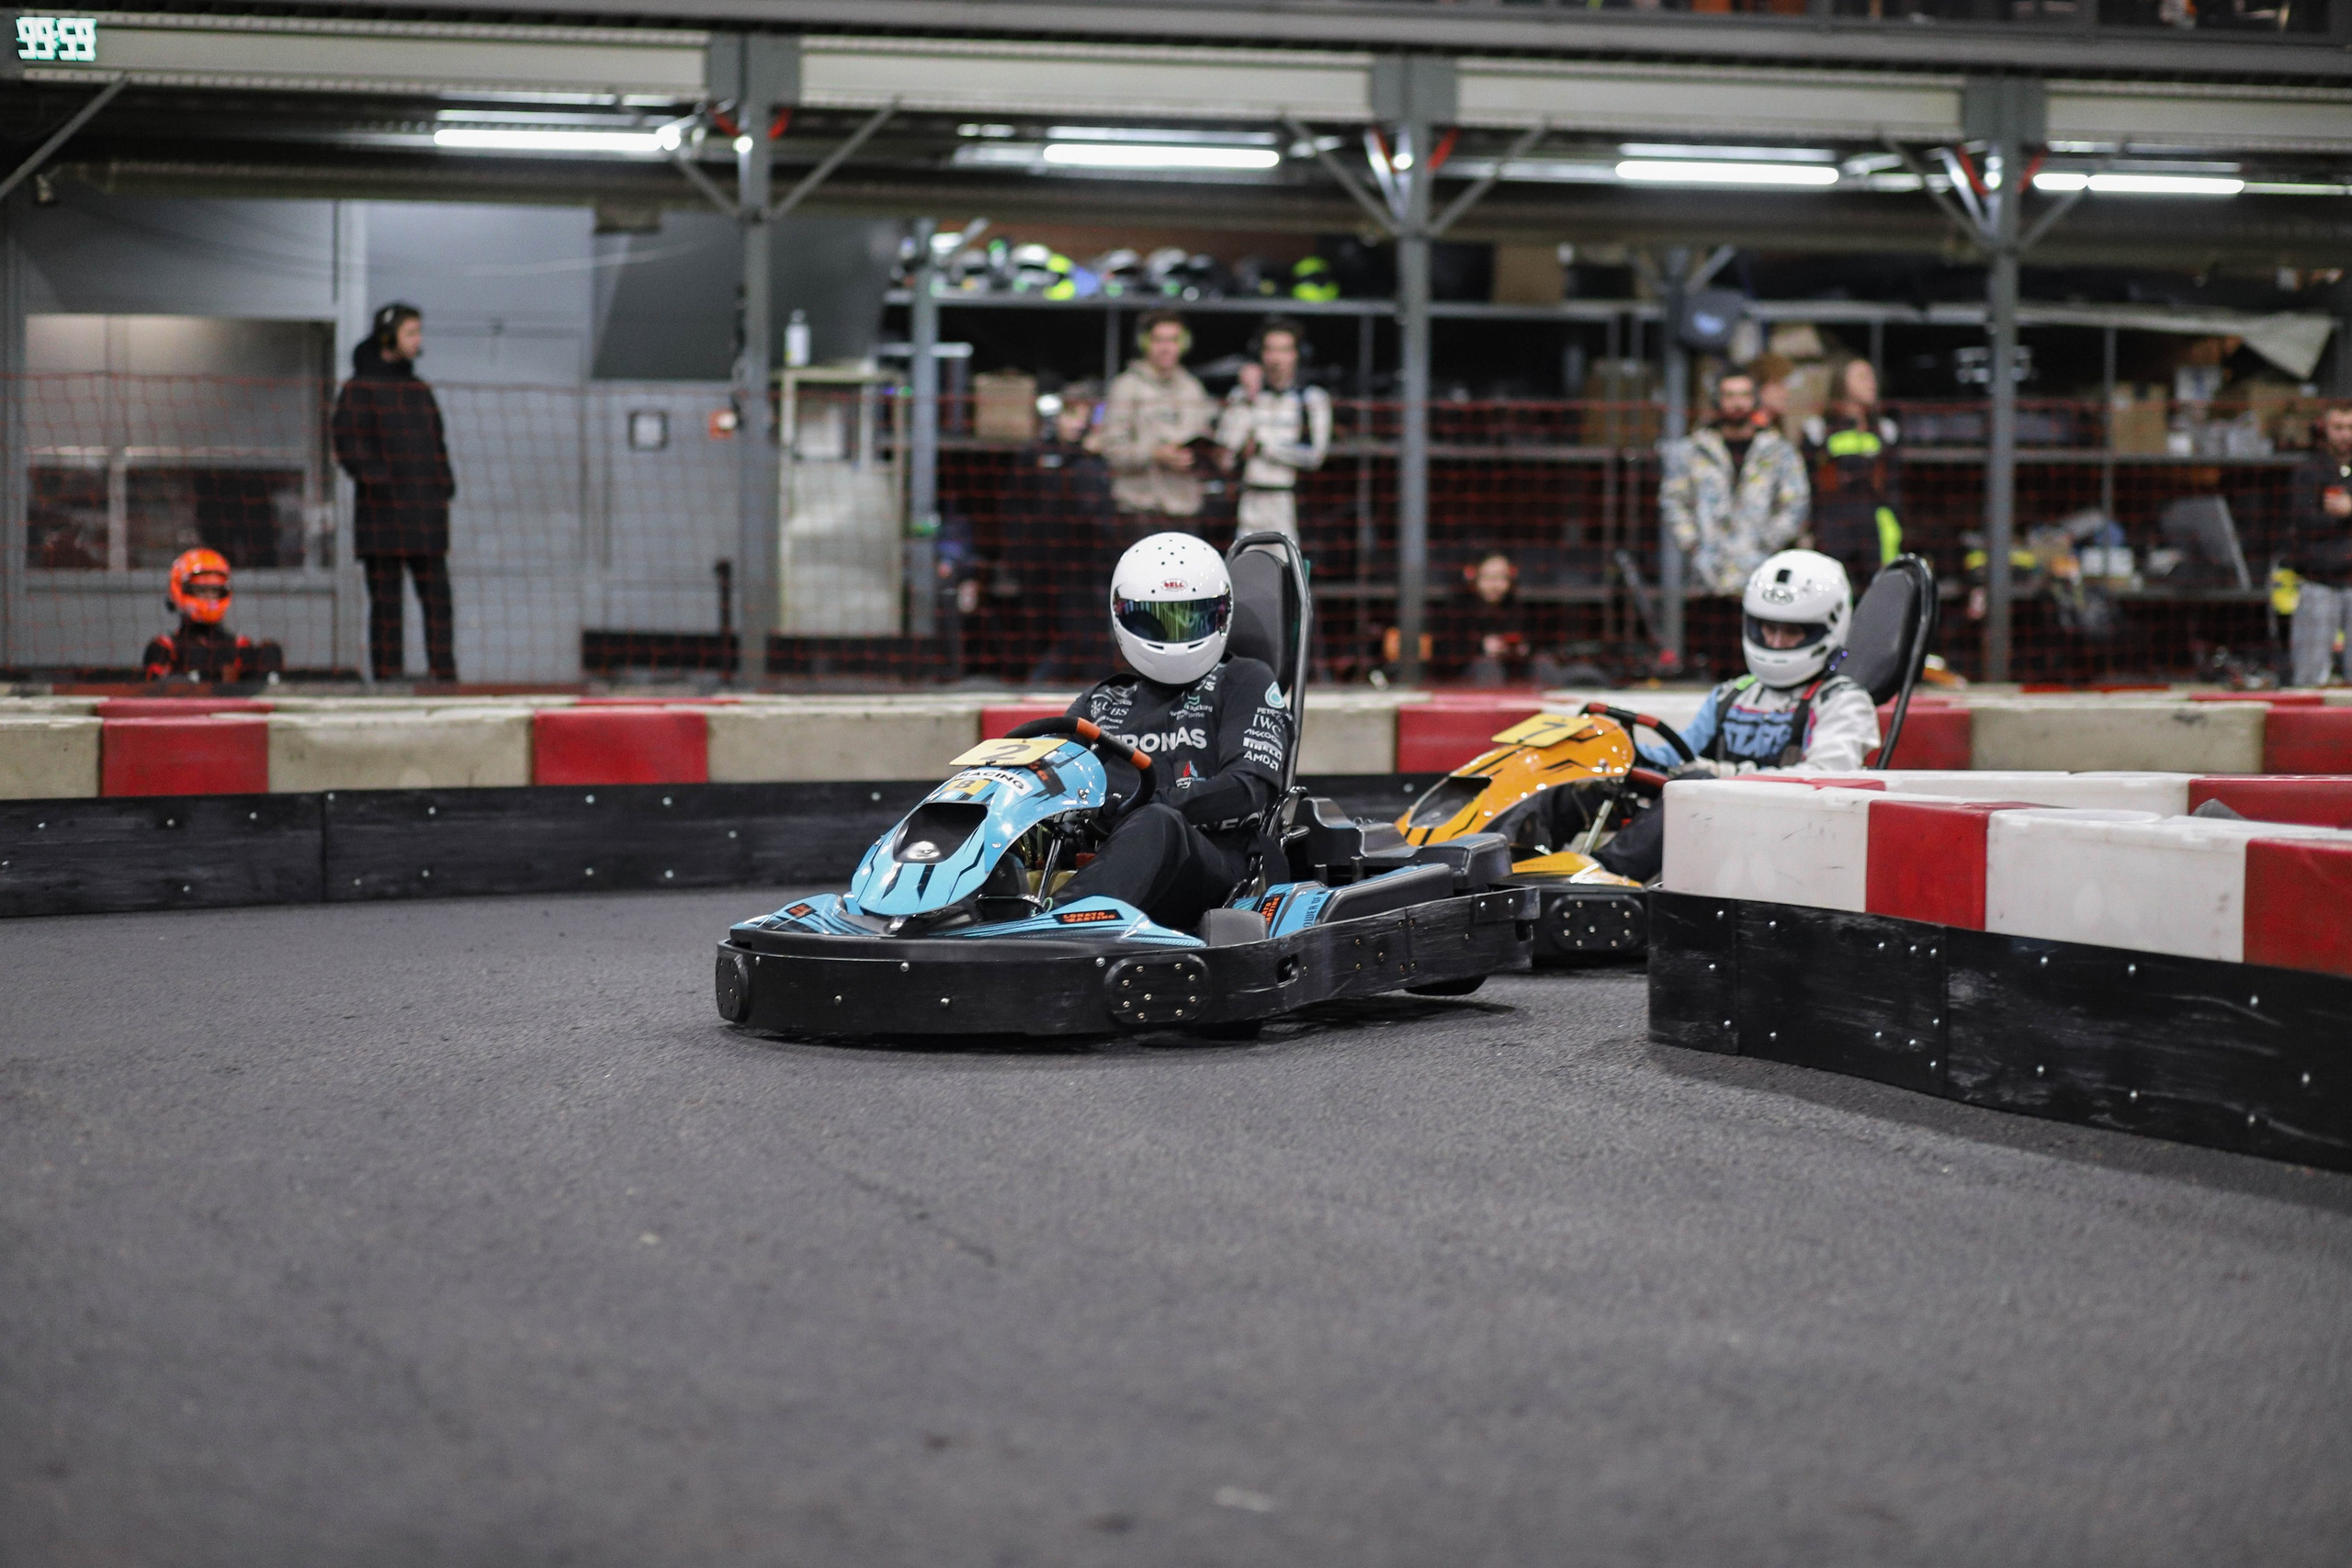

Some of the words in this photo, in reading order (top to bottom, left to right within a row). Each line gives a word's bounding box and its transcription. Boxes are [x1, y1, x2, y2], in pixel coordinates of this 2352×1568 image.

[16, 17, 96, 62] 99:59
[1102, 701, 1128, 716] UBS
[1252, 714, 1282, 739] IWC
[978, 744, 1031, 761] 2
[1243, 750, 1271, 765] AMD
[953, 779, 976, 789] 8
[958, 771, 1025, 790] RACING
[1303, 903, 1318, 928] OWER
